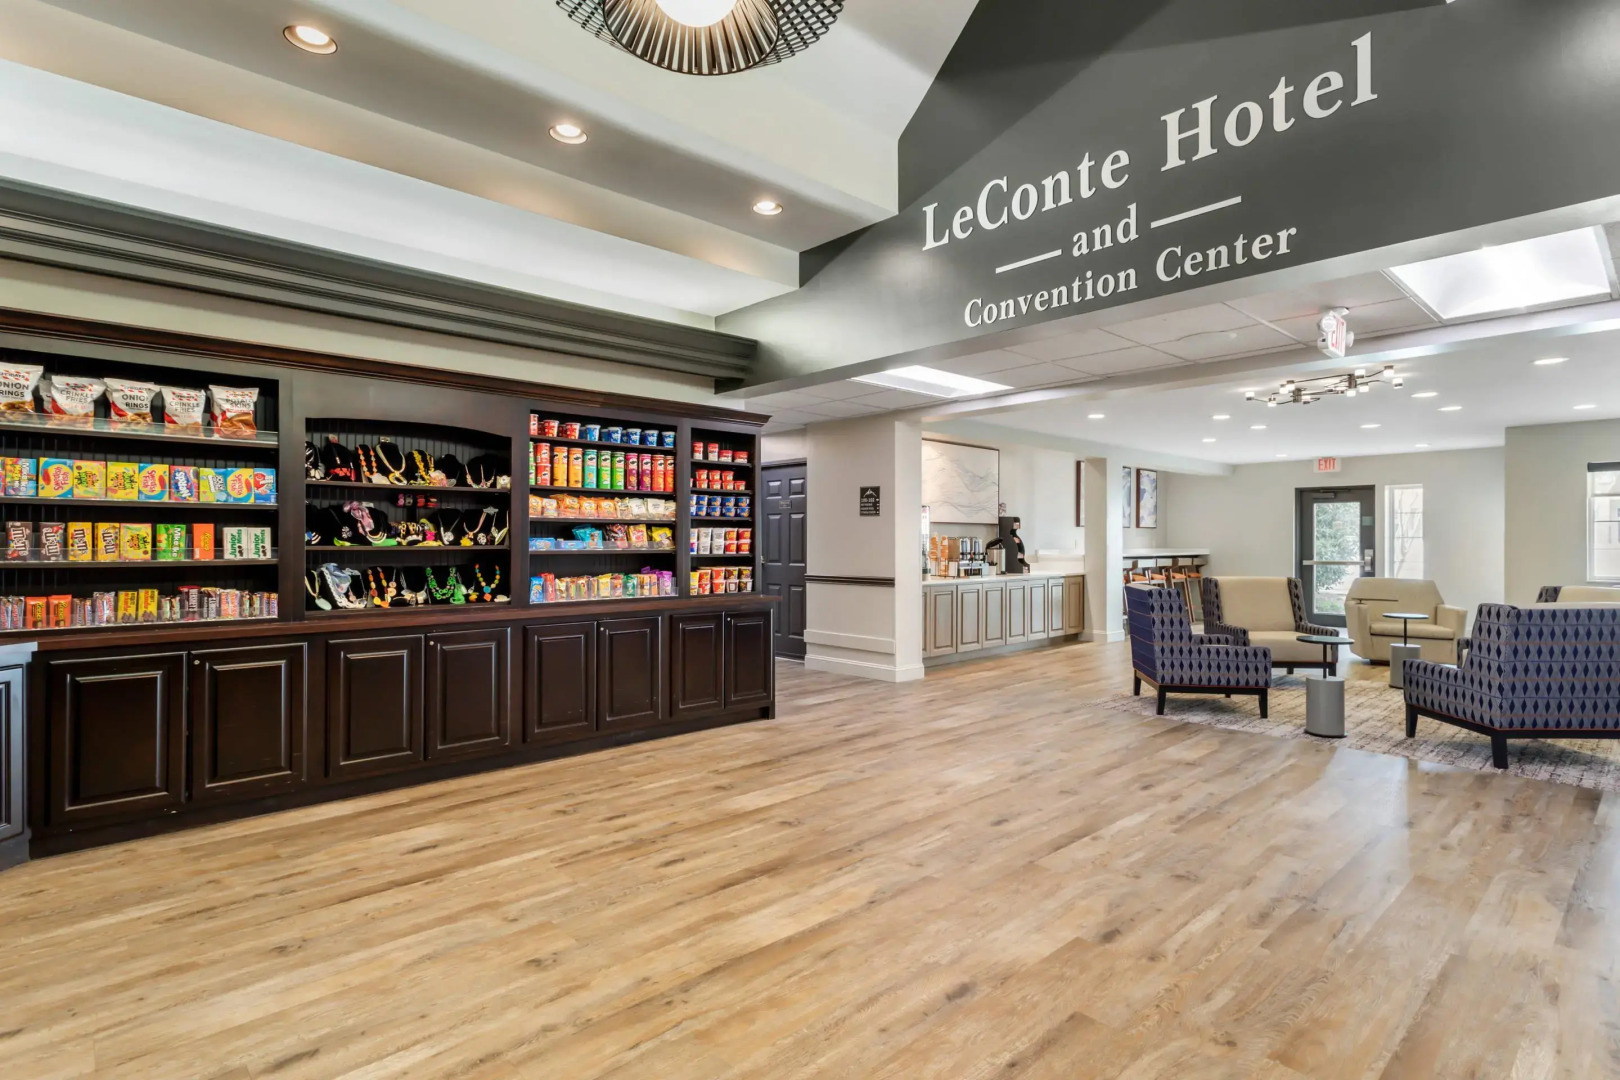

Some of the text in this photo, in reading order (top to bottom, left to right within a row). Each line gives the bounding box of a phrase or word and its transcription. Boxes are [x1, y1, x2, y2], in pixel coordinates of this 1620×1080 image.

[922, 31, 1378, 251] LeConte Hotel
[1072, 203, 1139, 257] and
[964, 227, 1297, 327] Convention Center
[125, 401, 149, 409] RINGS
[1318, 457, 1336, 471] EXIT
[229, 533, 237, 557] Junior
[253, 533, 261, 557] Junior
